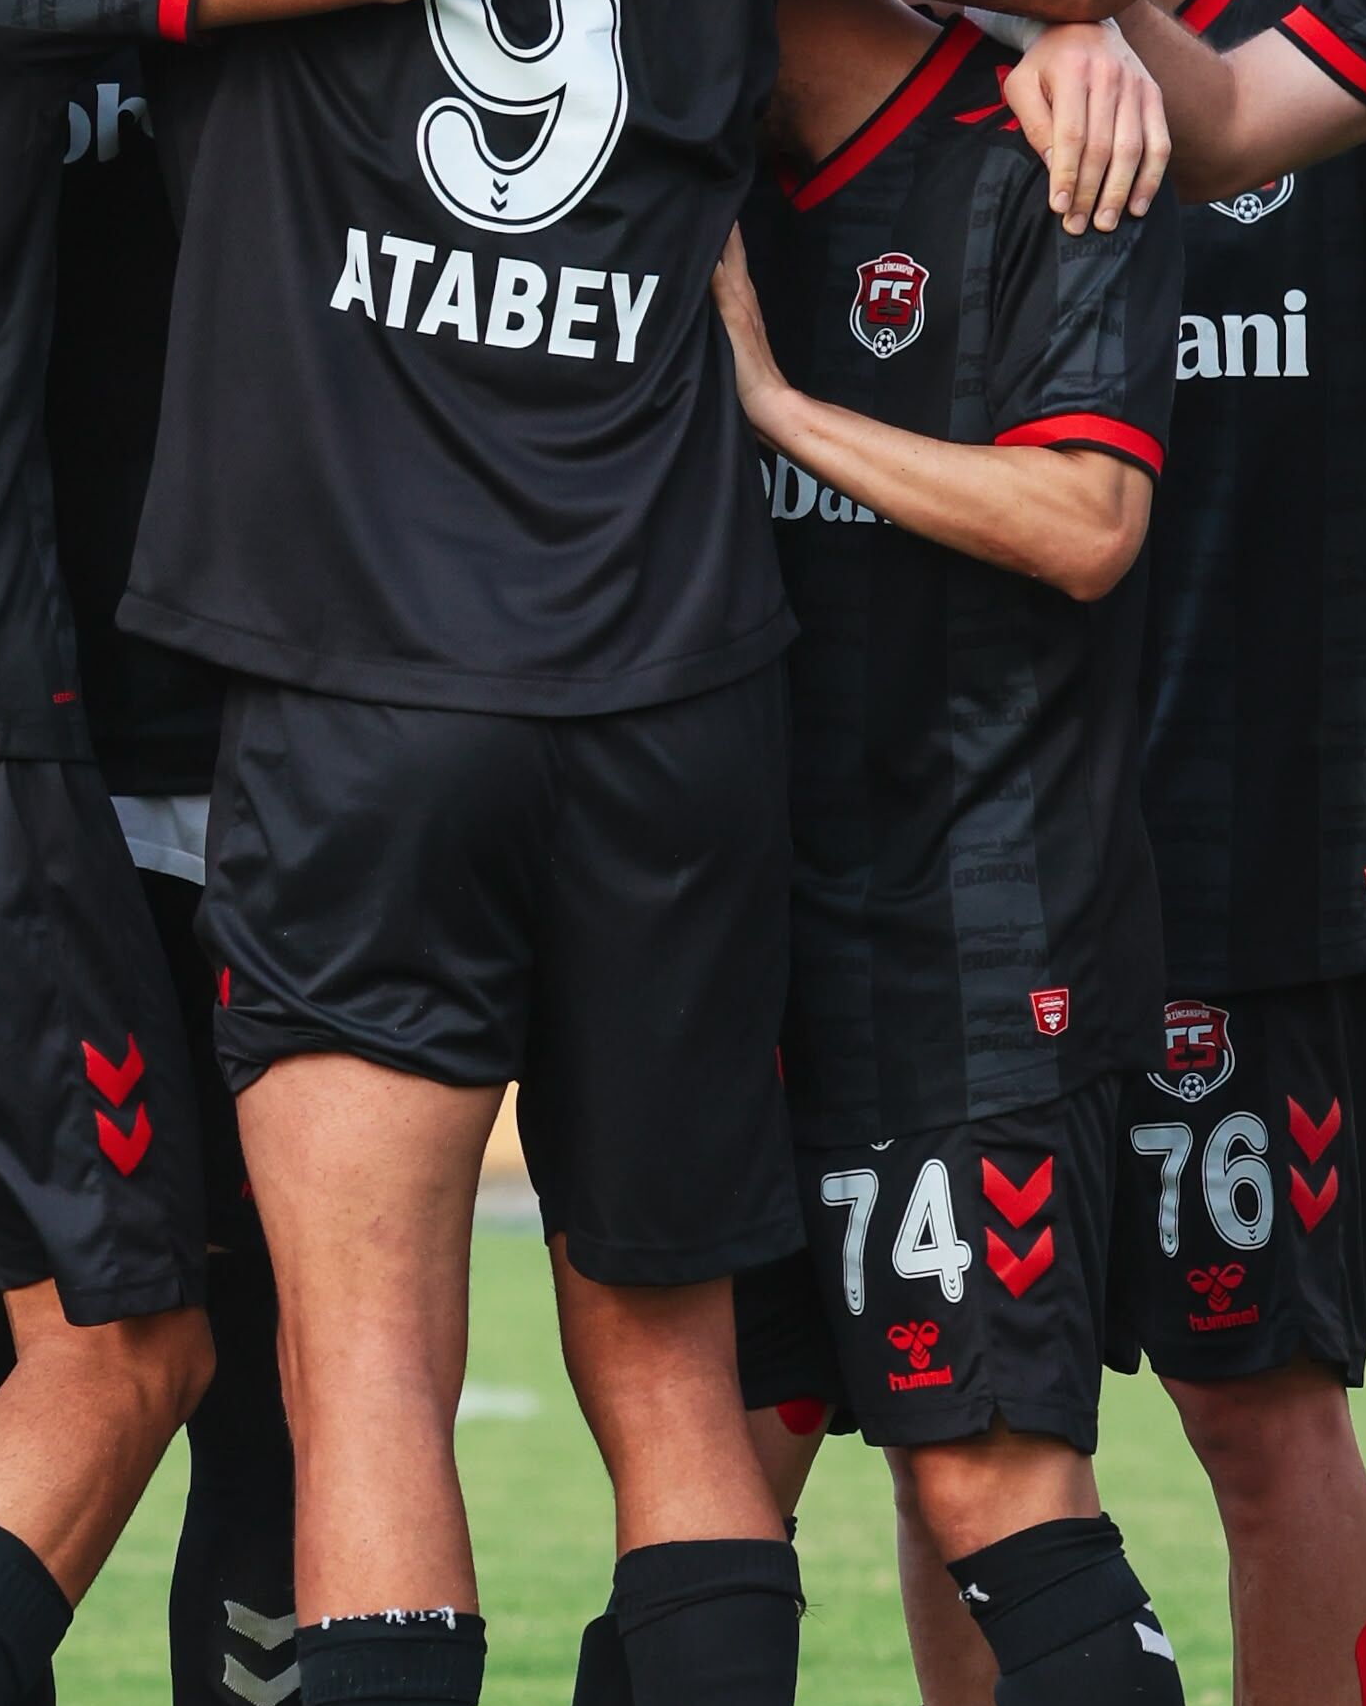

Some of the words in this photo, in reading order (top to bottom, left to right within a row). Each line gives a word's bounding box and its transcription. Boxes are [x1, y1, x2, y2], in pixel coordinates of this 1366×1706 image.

[330, 229, 659, 364] ATABEY
[821, 1159, 971, 1315] 74
[1131, 1112, 1274, 1258] 76
[889, 1364, 953, 1392] hummel
[1188, 1304, 1260, 1332] hummel
